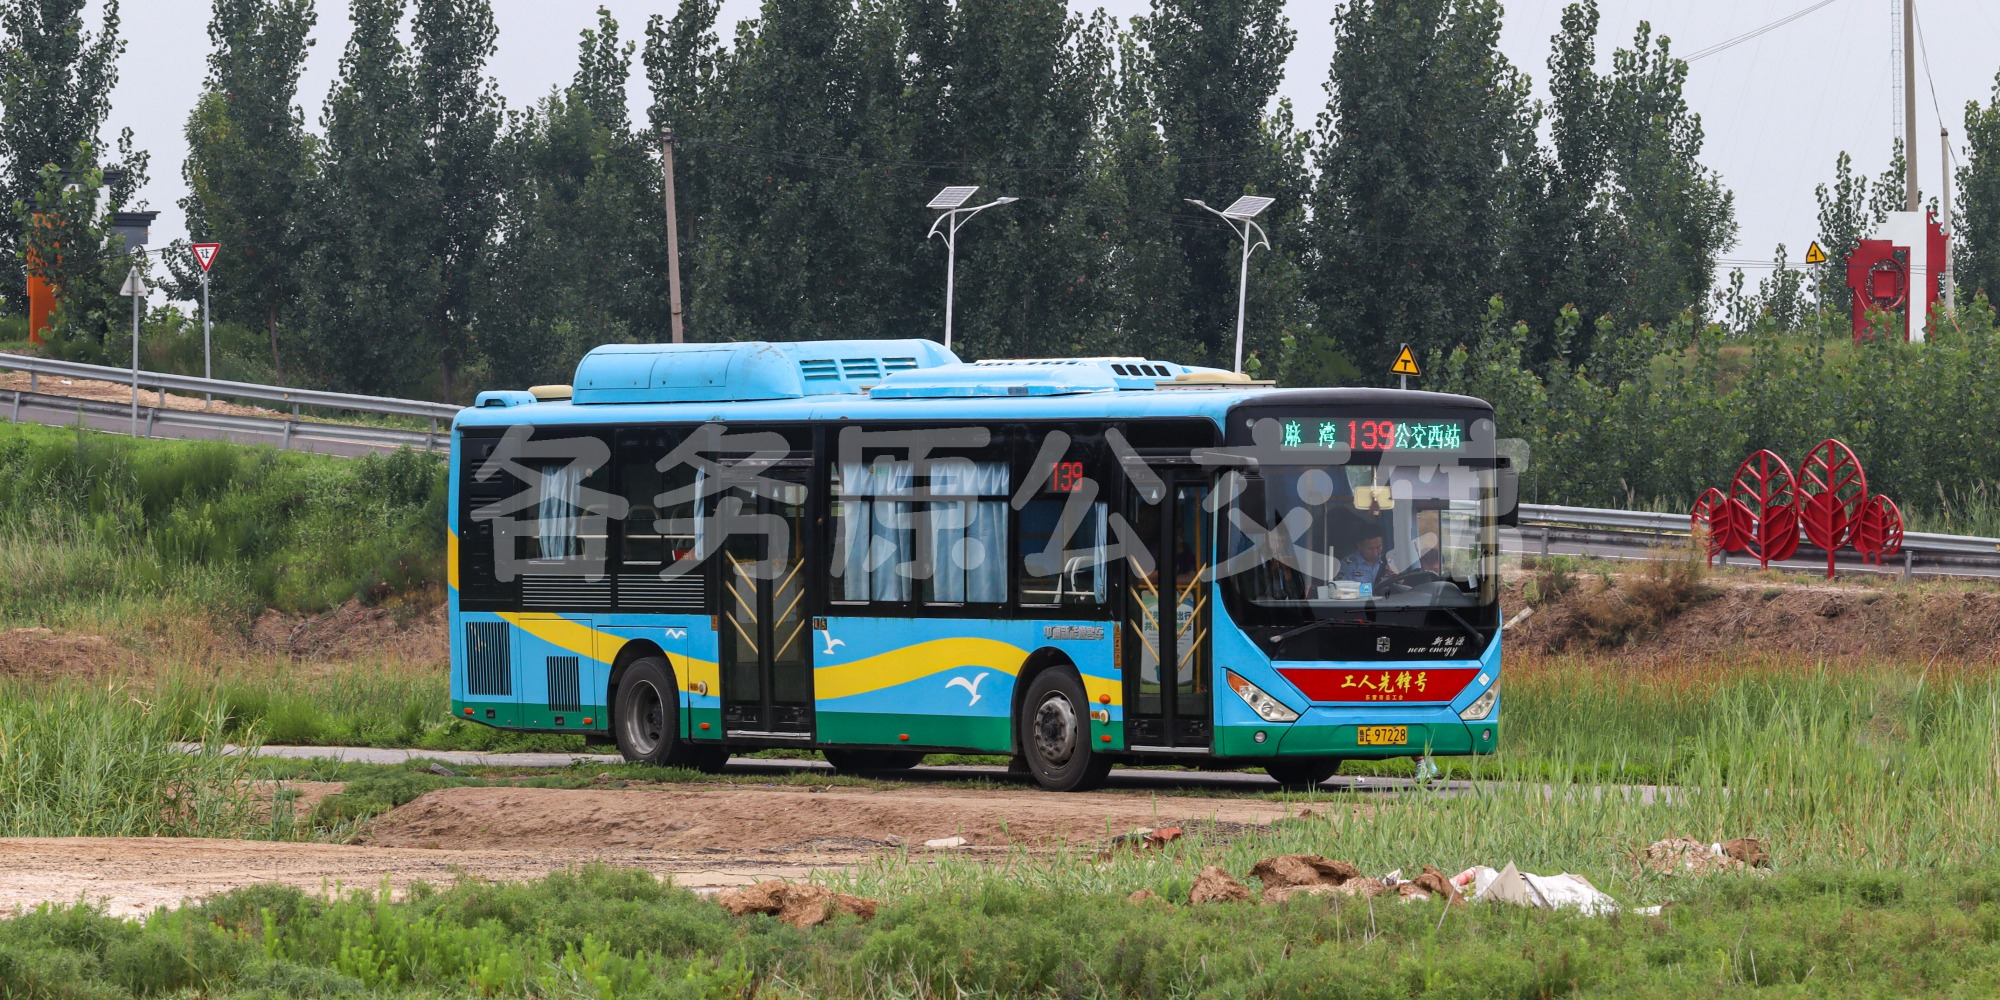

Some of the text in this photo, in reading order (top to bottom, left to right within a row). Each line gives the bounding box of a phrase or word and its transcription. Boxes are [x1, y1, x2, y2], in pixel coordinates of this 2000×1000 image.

[200, 248, 210, 258] 让
[1348, 420, 1395, 449] 139
[1394, 422, 1461, 449] 公交西站
[1053, 461, 1083, 492] 139
[1429, 646, 1458, 657] energy
[1341, 671, 1428, 694] 工人先锋号
